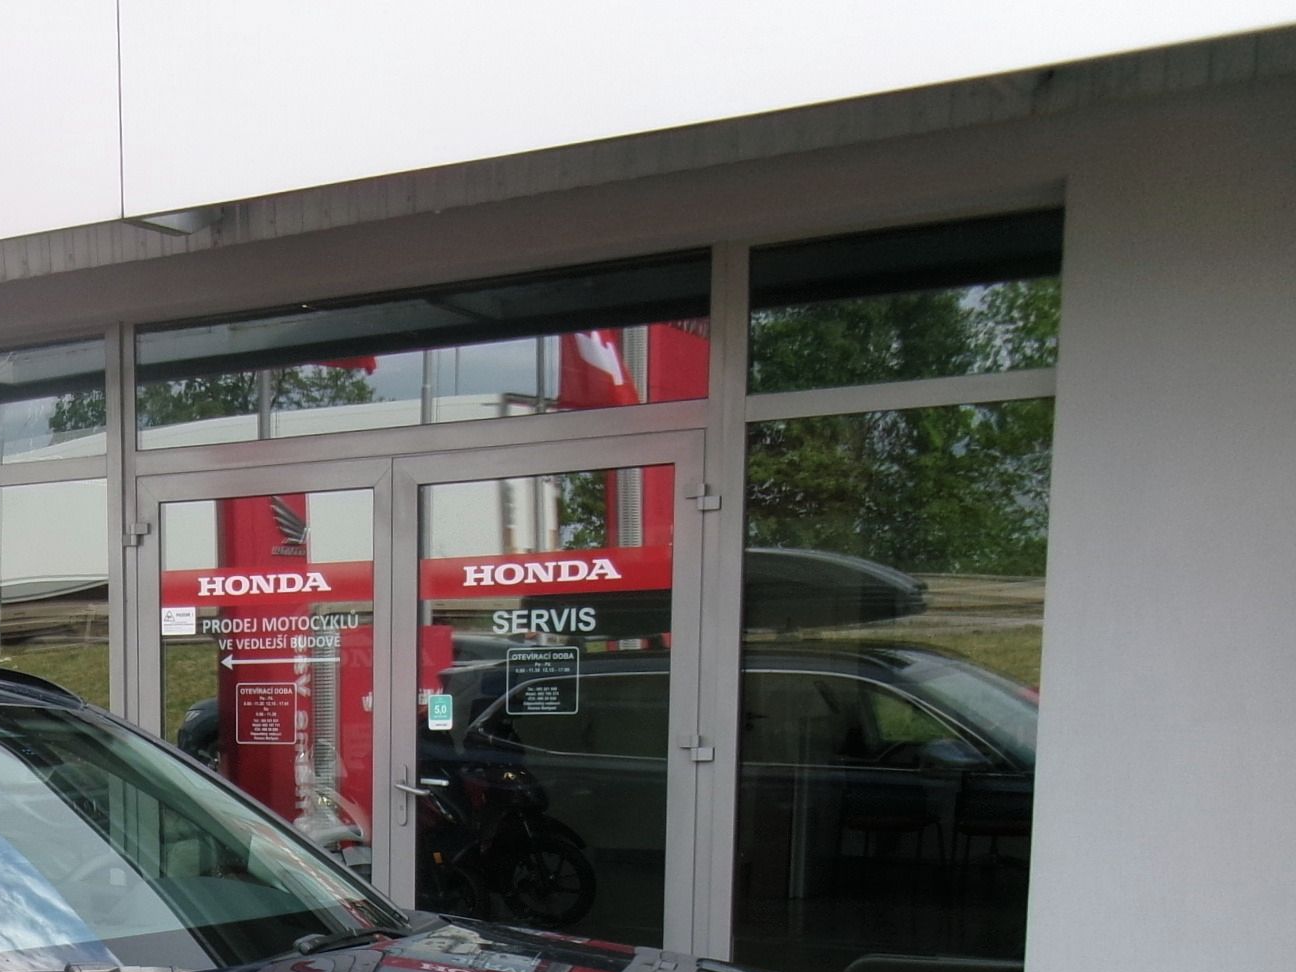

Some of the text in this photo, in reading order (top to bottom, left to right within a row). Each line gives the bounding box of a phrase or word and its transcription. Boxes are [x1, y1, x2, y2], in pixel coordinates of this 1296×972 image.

[198, 572, 332, 596] HONDA
[463, 558, 622, 587] HONDA
[202, 617, 257, 634] PRODEJ
[262, 609, 359, 632] MOTOCYKLŮ
[492, 607, 597, 634] SERVIS
[218, 632, 341, 651] VE VEDLEJŠÍ BUDOVĚ
[552, 652, 575, 660] DOBA
